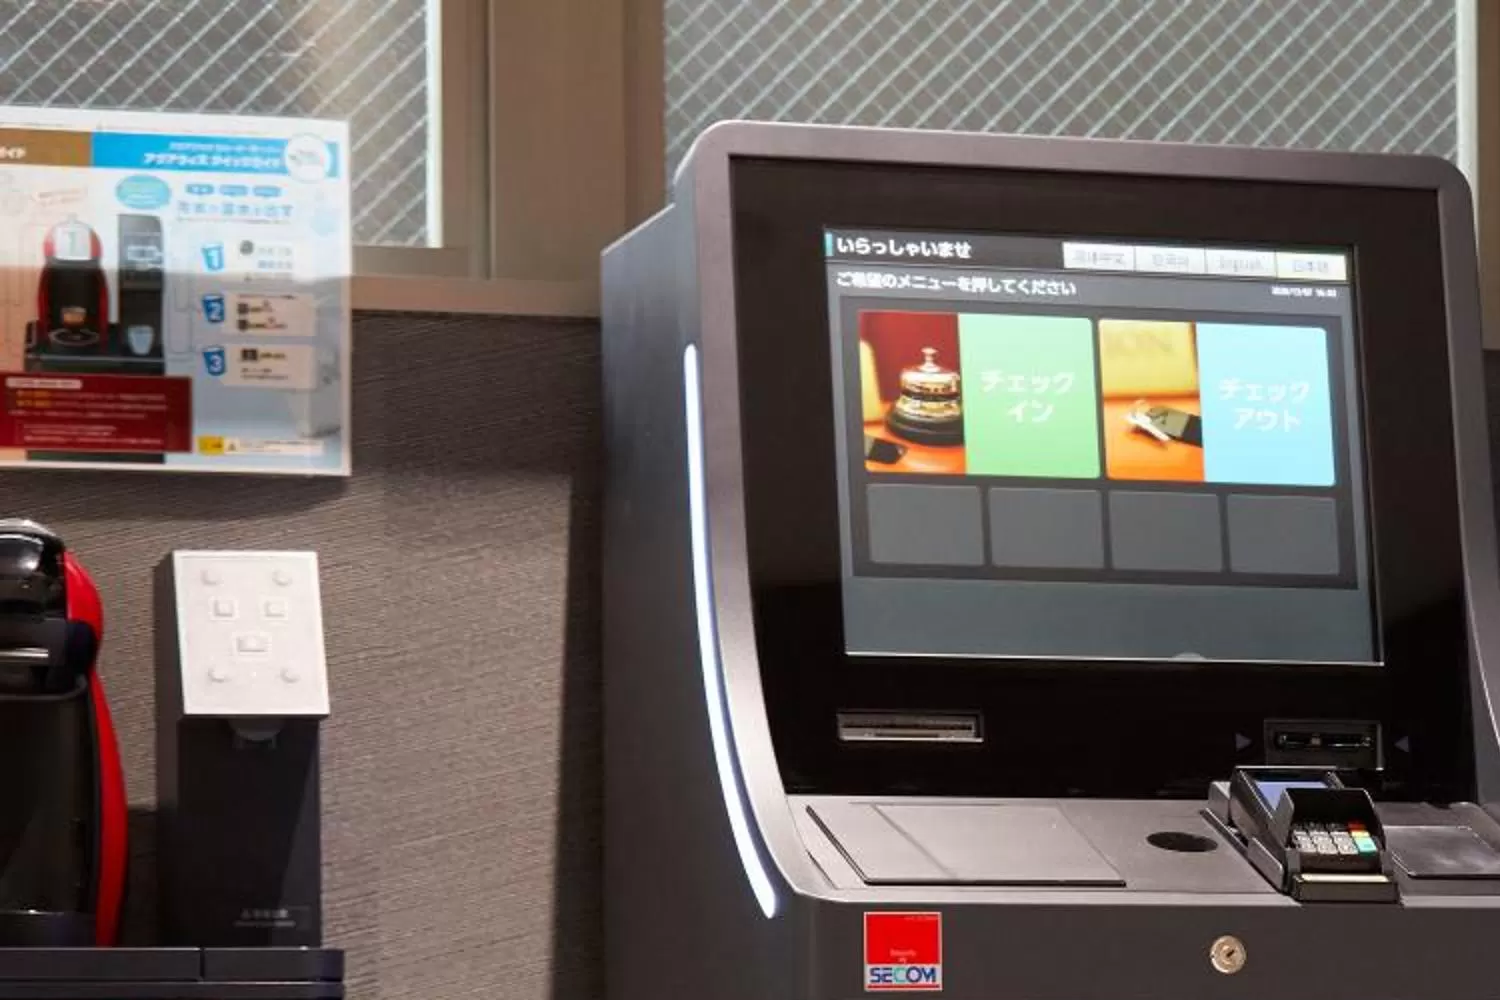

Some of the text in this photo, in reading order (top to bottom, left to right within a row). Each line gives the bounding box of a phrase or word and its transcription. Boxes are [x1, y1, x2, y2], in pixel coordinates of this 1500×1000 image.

[836, 236, 973, 259] いらっしゃいませ
[836, 270, 1078, 297] ご希望のメニューを押してください
[979, 370, 1076, 394] チェック
[1218, 377, 1312, 401] チェック
[1007, 399, 1054, 423] イン
[1232, 407, 1304, 433] アウト
[870, 966, 936, 983] SECOM
